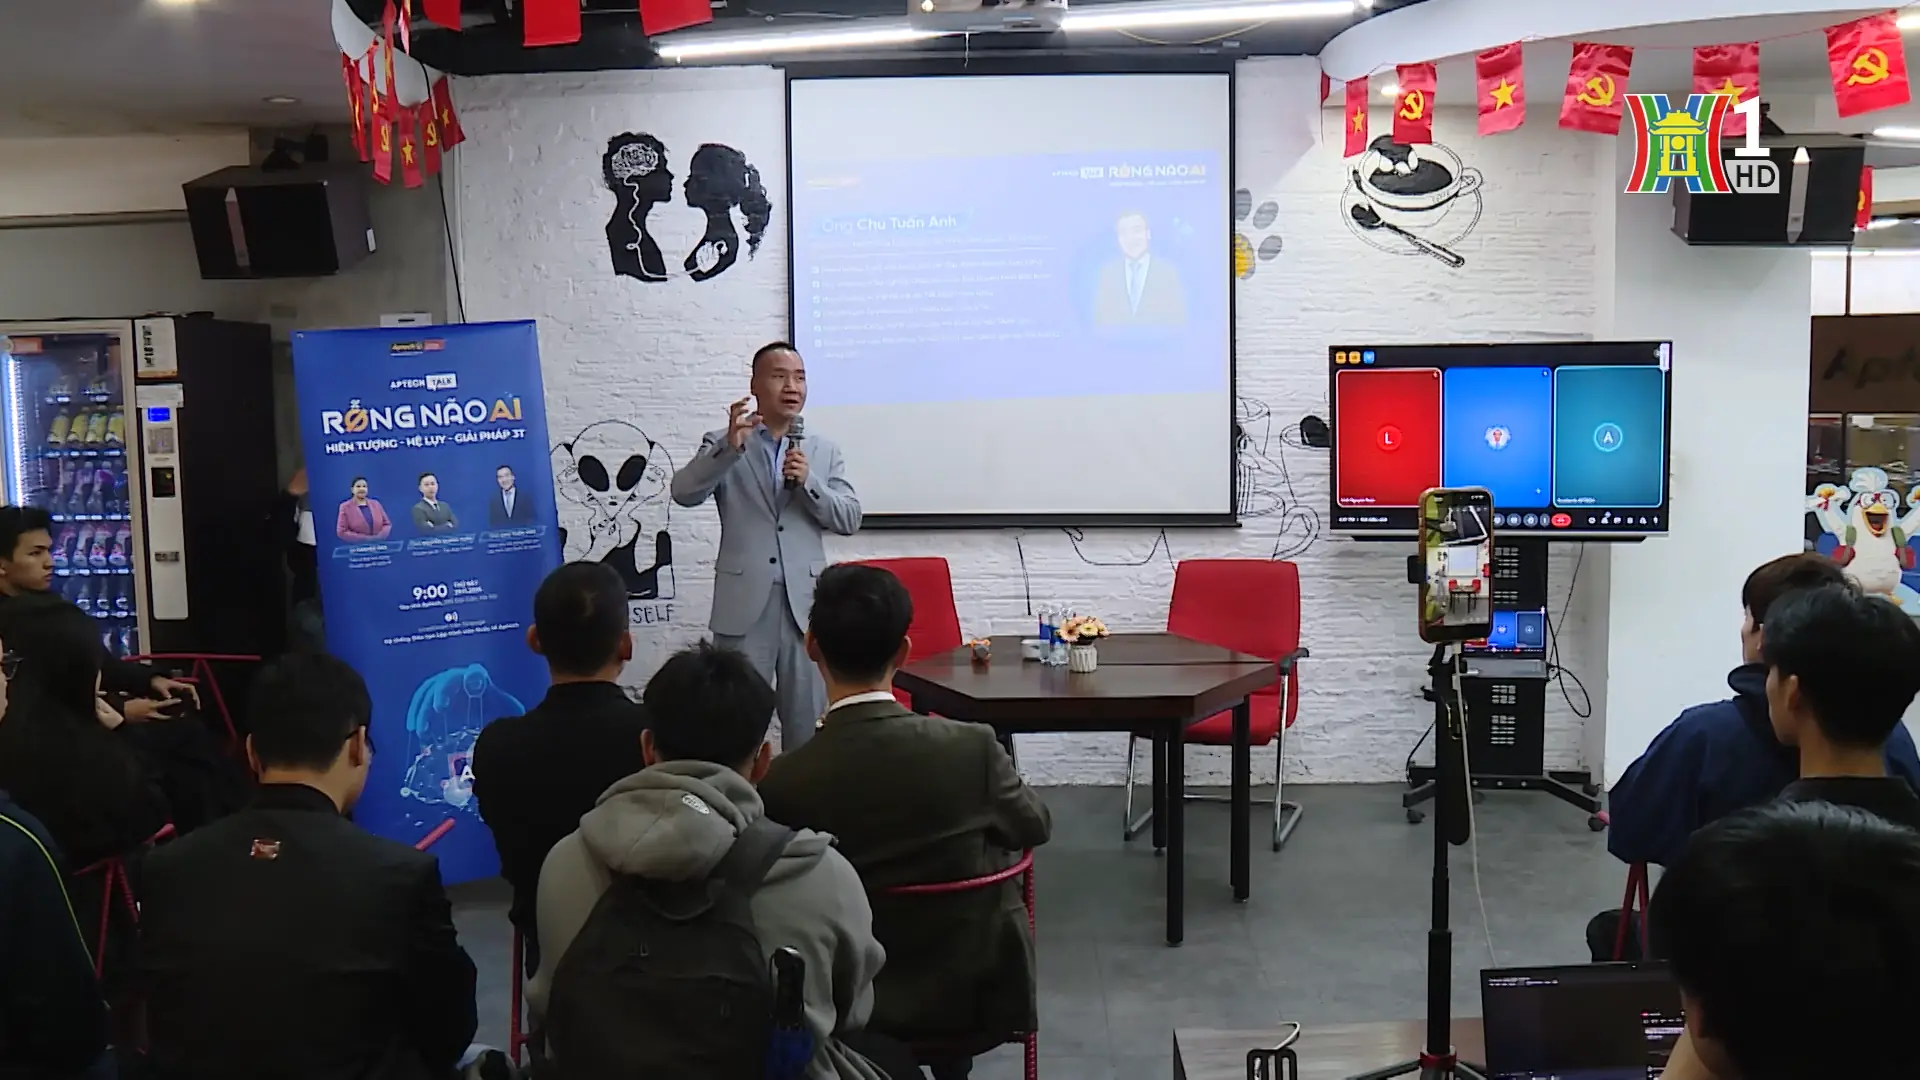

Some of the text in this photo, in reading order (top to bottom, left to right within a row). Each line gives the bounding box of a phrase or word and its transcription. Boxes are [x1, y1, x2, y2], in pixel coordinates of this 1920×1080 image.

[857, 217, 886, 231] Chu
[928, 214, 957, 228] Anh
[390, 377, 453, 390] APTECH TALK
[421, 397, 487, 426] NÃO
[489, 397, 523, 422] AI
[325, 441, 355, 456] HIỆN
[356, 438, 398, 452] TƯỢNG
[406, 436, 423, 449] HỆ
[455, 430, 478, 443] GIẢI
[479, 428, 511, 442] PHÁP
[512, 428, 526, 439] 3T
[1384, 431, 1393, 445] L
[1603, 431, 1614, 444] A
[412, 584, 448, 600] 9:00
[632, 604, 675, 624] SELF
